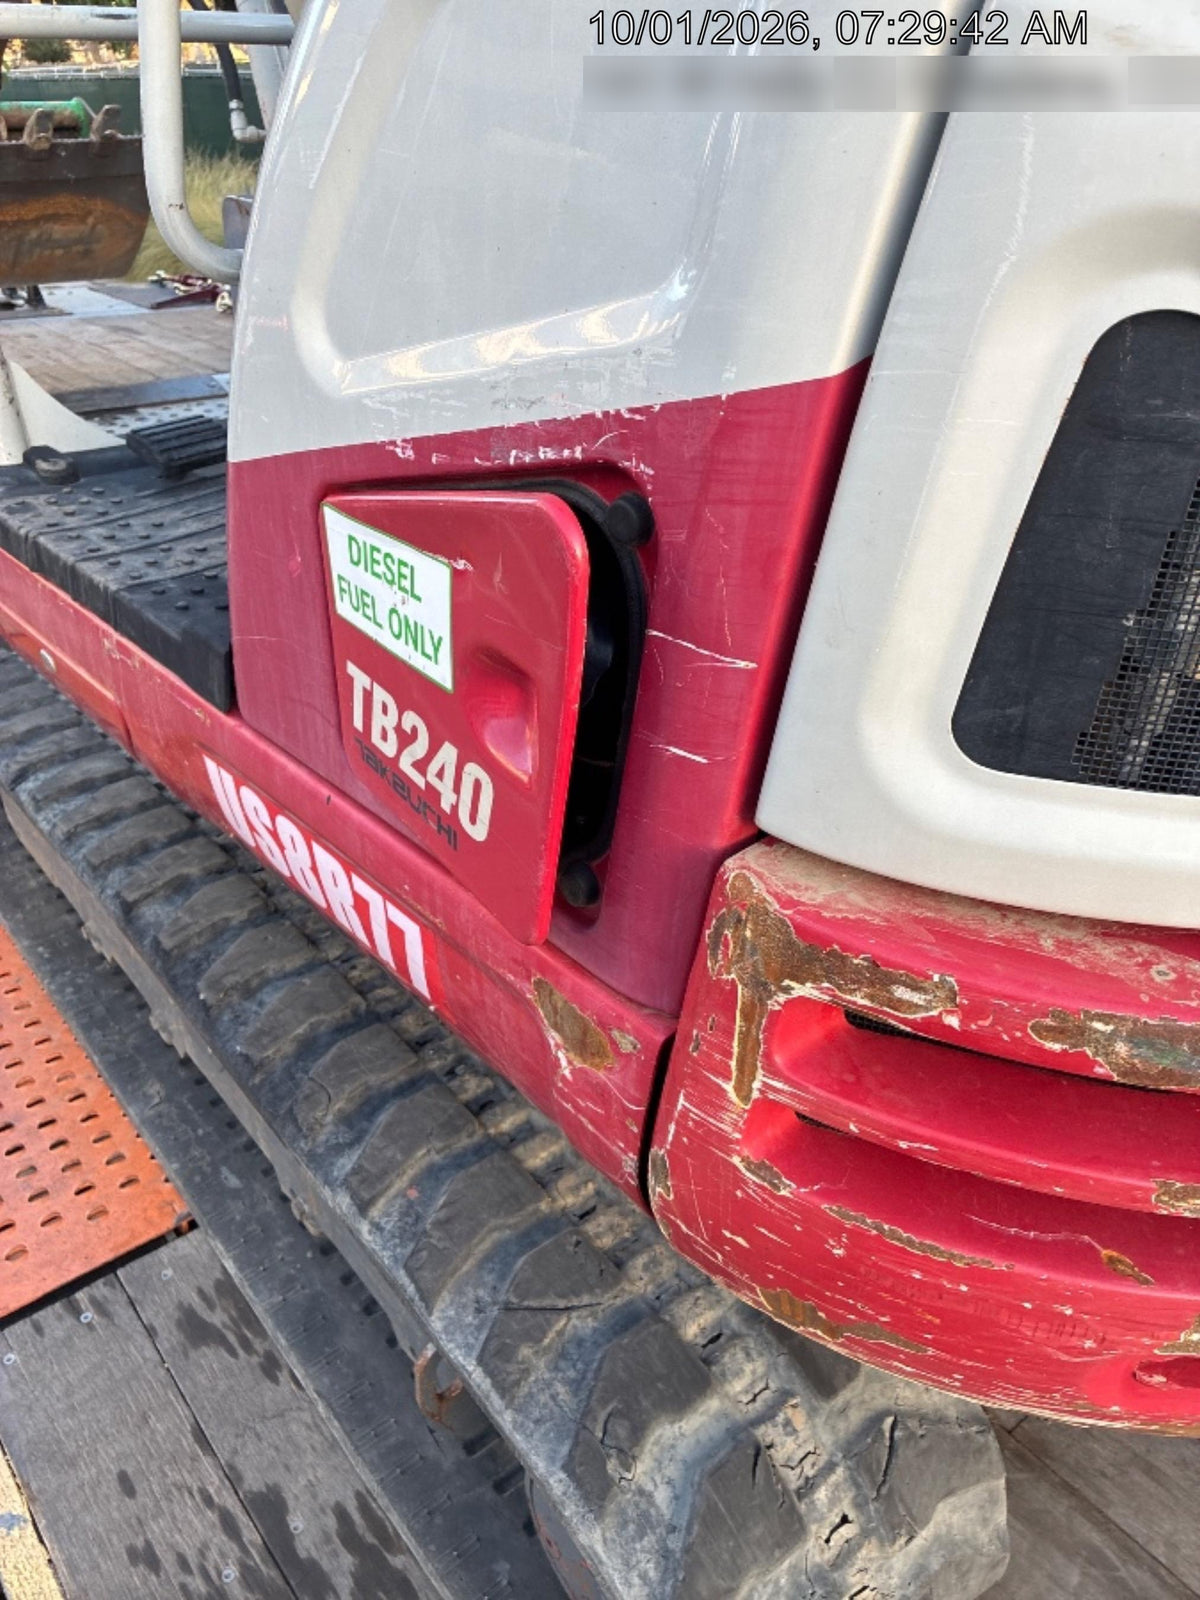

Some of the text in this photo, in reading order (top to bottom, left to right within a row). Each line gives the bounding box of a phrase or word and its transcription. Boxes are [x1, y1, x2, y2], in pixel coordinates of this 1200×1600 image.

[337, 573, 443, 665] FUEL ONLY
[347, 534, 422, 603] DIESEL
[346, 659, 494, 842] TB240
[202, 753, 432, 1001] US8R77
